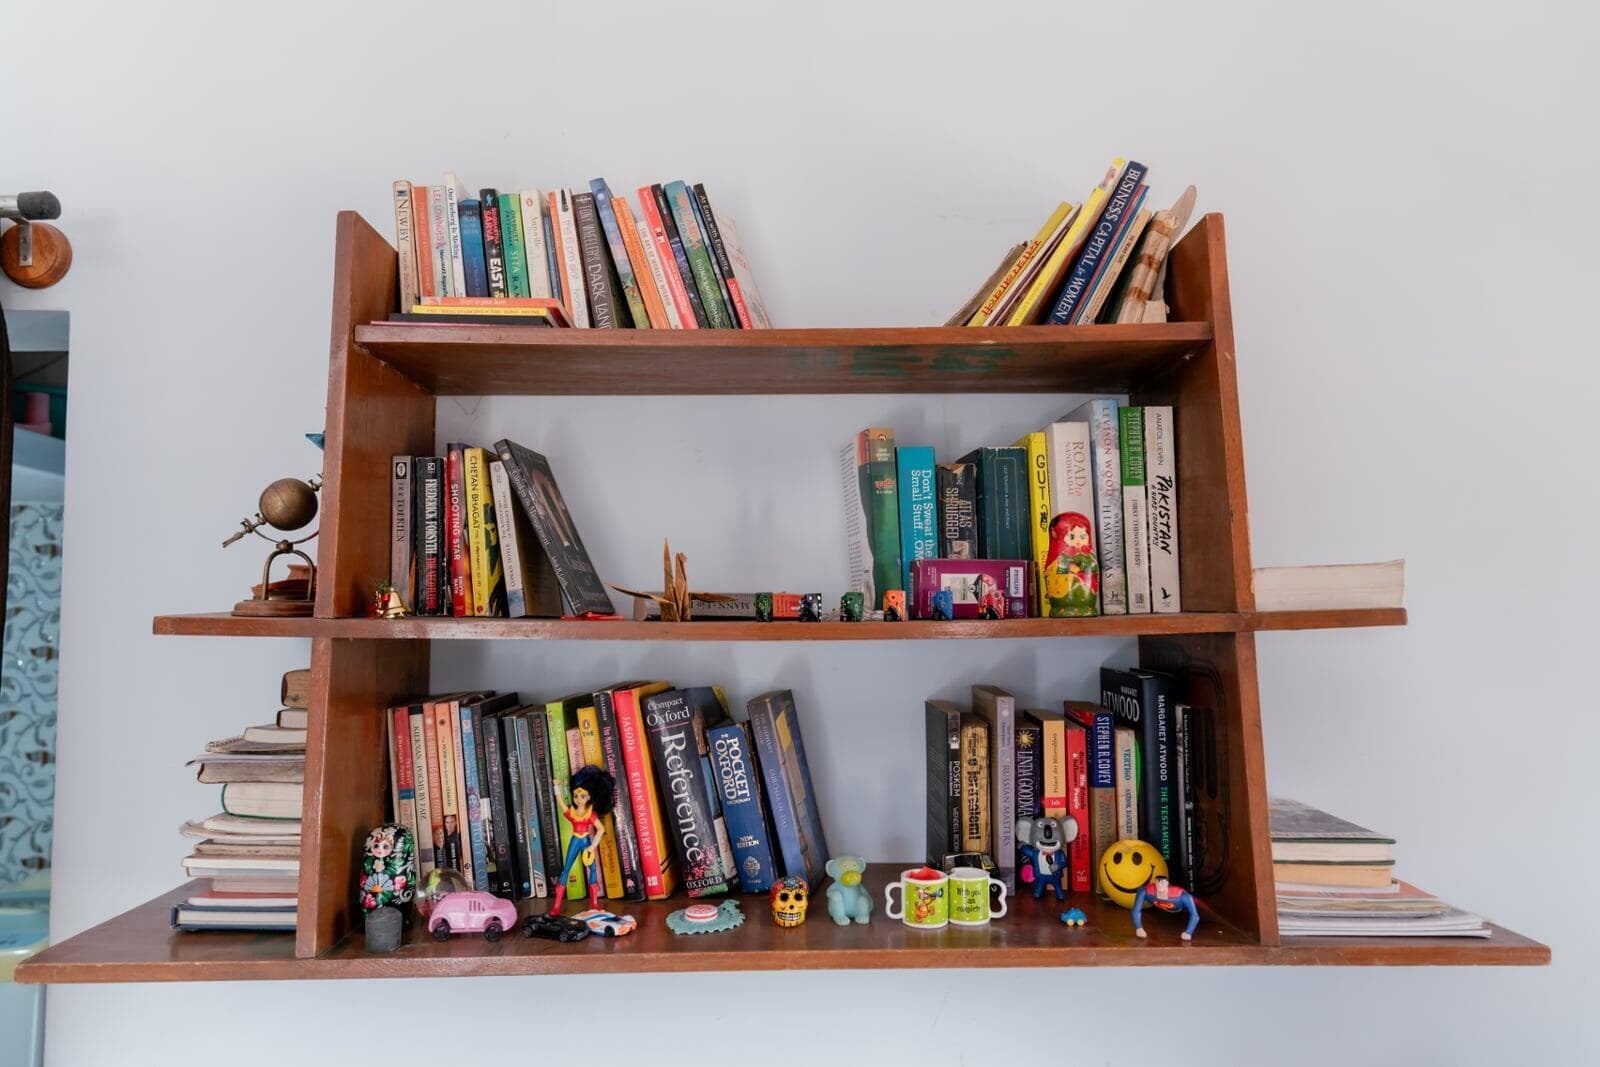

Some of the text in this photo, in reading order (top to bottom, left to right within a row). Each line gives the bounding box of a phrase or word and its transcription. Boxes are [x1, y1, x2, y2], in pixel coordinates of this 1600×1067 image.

[448, 188, 456, 201] Our
[578, 204, 592, 222] TONY
[700, 195, 707, 204] At
[703, 204, 712, 221] Ease
[1105, 168, 1141, 221] BUSINESS
[398, 198, 409, 242] NEWBY
[434, 204, 444, 241] LOWNDES
[449, 202, 458, 226] Iceberg
[483, 210, 493, 242] SARVA
[708, 222, 718, 238] with
[452, 235, 460, 259] Melting
[511, 249, 520, 273] SITA
[1081, 222, 1112, 266] CAPITAL
[489, 257, 504, 289] EAST
[588, 263, 605, 302] DARK
[596, 304, 613, 329] LAN
[1055, 277, 1084, 320] WOMEN
[1128, 412, 1142, 446] STEPHEN
[1155, 412, 1164, 466] ANATOL LIEVEN
[1073, 441, 1087, 487] ROAD
[1102, 406, 1115, 497] LEVISON WOOD
[1129, 455, 1143, 480] COVEY
[469, 456, 480, 530] CHETAN BHAGAT
[911, 469, 921, 501] Small
[922, 469, 933, 500] Don't
[1035, 454, 1047, 501] GUT
[425, 478, 437, 520] FREDERICK
[945, 487, 959, 539] SHRUGGED
[959, 499, 972, 528] ATLAS
[1155, 474, 1173, 555] PAKISTAN
[396, 499, 405, 543] TOLKIEN
[425, 521, 438, 554] FORSYTH
[450, 483, 461, 561] SHOOTING STAR
[923, 502, 933, 537] Sweat
[1131, 498, 1141, 567] FIRST THINGS FIRST
[924, 539, 934, 558] the
[1102, 504, 1114, 579] HIMALAYAS
[646, 705, 690, 727] Oxford
[647, 697, 684, 711] Compact
[1103, 690, 1140, 722] ATWOOD
[603, 726, 612, 736] The
[604, 736, 614, 753] Mayan
[606, 753, 616, 778] Calendar
[729, 736, 751, 797] POCKET
[1096, 716, 1112, 785] STEPHEN R. COVEY
[1124, 748, 1132, 781] VERTIGO
[414, 726, 427, 820] KIERNAN POEMS BY FAIZ
[621, 715, 653, 857] JASODA KIRAN NAGARKAR
[715, 739, 738, 801] OXFORD
[1017, 750, 1034, 821] LINDA GOODMA
[1157, 694, 1170, 860] MARGARET ATWOOD THE TESTAMENTS
[660, 730, 702, 864] Reference
[1002, 764, 1011, 847] RUSSIAN MASTERS
[1073, 786, 1081, 809] People
[471, 820, 484, 857] HOLY
